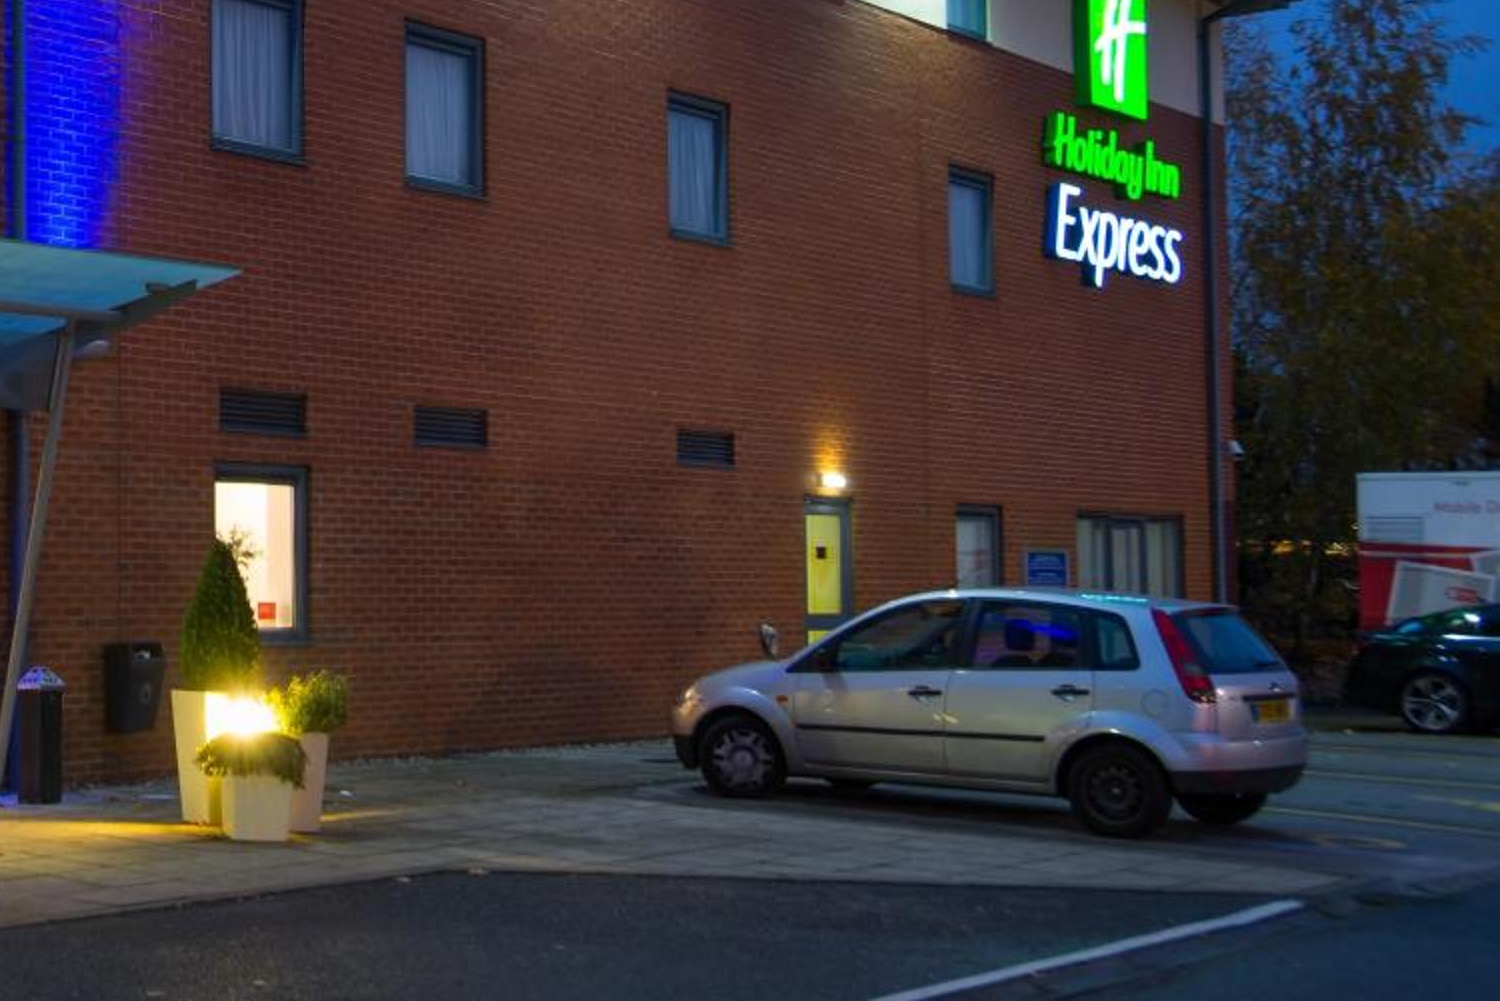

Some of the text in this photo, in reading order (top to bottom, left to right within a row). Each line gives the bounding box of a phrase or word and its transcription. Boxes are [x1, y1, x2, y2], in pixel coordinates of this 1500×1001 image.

[1053, 111, 1180, 200] Holiday Inn
[1055, 182, 1182, 288] Express
